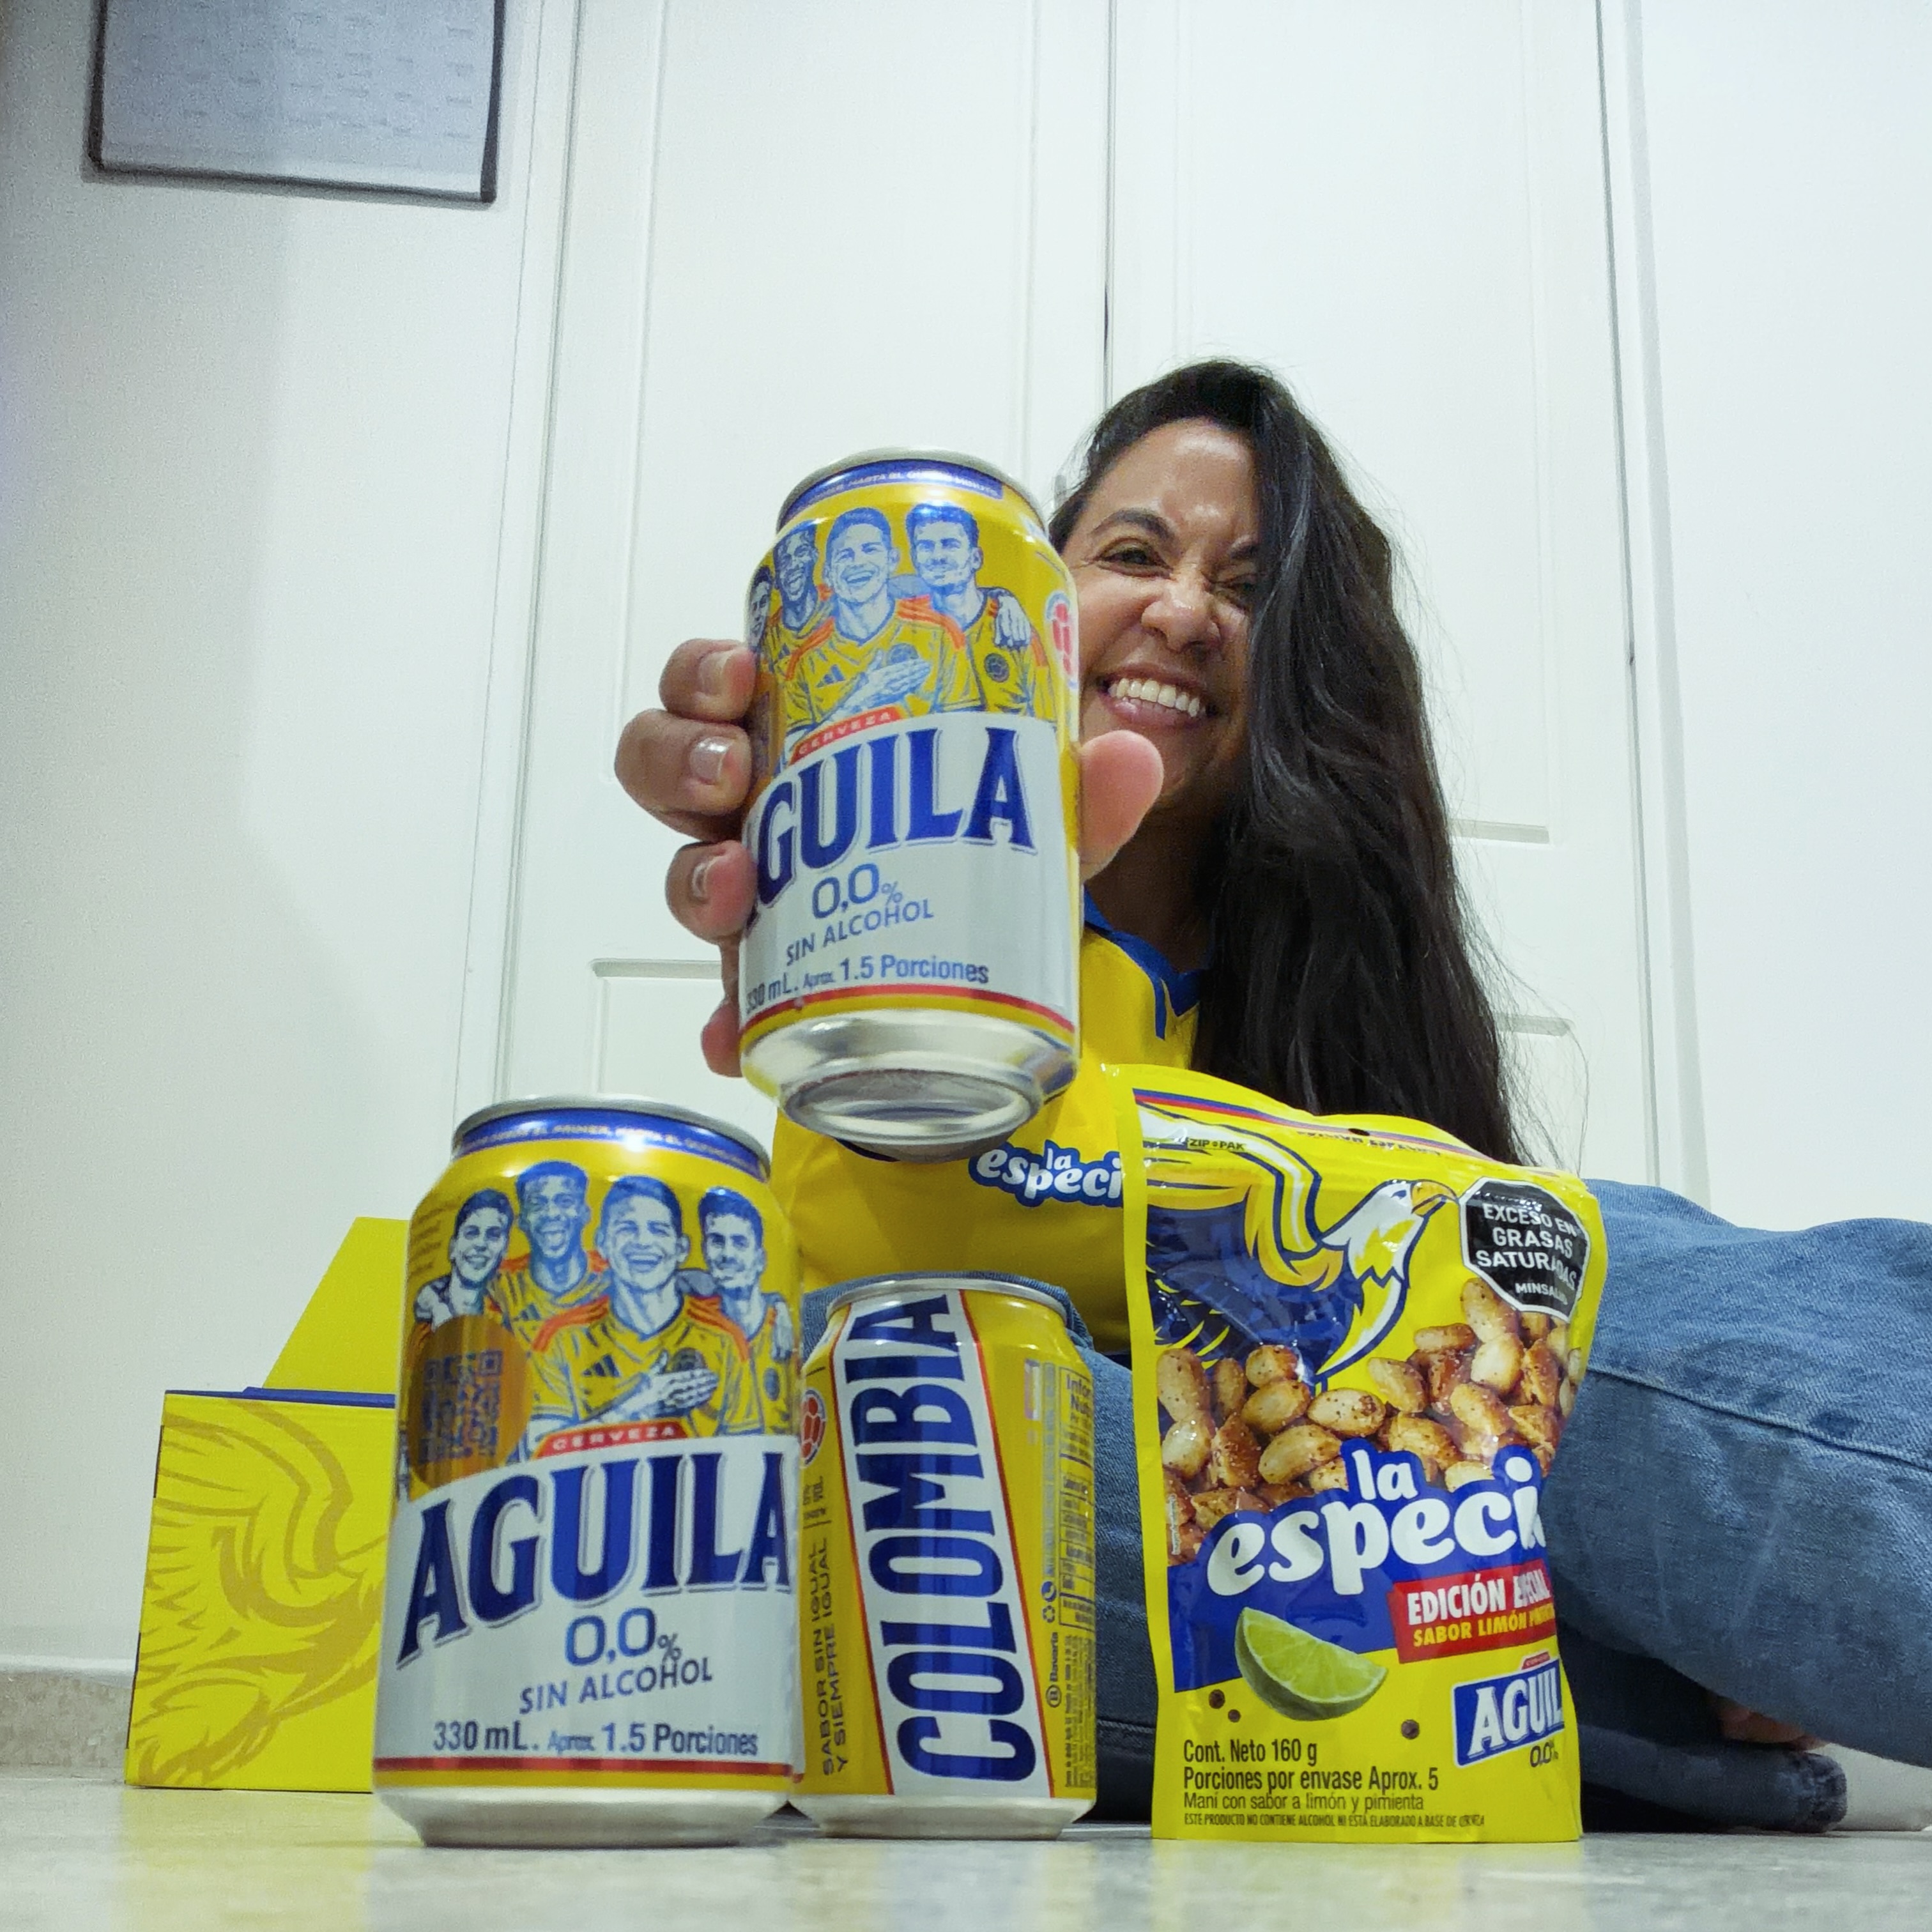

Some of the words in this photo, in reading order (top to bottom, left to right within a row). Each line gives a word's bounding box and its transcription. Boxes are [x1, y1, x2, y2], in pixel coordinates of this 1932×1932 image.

[799, 711, 893, 755] CERVEZA
[746, 726, 1037, 934] GUILA
[786, 933, 815, 966] SIN
[823, 899, 934, 947] ALCOHOL
[841, 958, 874, 982] 1.5
[880, 955, 989, 984] Porciones
[1046, 1148, 1071, 1170] la
[1482, 1204, 1552, 1227] EXCESO
[1554, 1218, 1577, 1238] EN
[1492, 1227, 1572, 1259] GRASAS
[552, 1424, 676, 1452] CERVEZA
[1351, 1449, 1418, 1501] la
[397, 1450, 791, 1669] AGUILA
[844, 1294, 1036, 1782] COLOMBIA
[808, 1543, 820, 1622] IGUAL
[820, 1538, 832, 1617] IGUAL
[1407, 1573, 1506, 1626] EDICIÓN
[1413, 1621, 1473, 1648] SABOR
[1477, 1609, 1528, 1637] LIMÓN
[813, 1629, 824, 1673] SIN
[519, 1681, 567, 1714] SIN
[579, 1657, 712, 1704] ALCOHOL
[825, 1623, 847, 1746] SIEMPRE
[433, 1720, 479, 1751] 330
[484, 1720, 539, 1752] mL.
[602, 1722, 645, 1752] 1.5
[654, 1723, 758, 1756] Porciones
[817, 1681, 834, 1775] SABOR
[836, 1756, 848, 1772] Y
[1184, 1739, 1225, 1763] Cont.
[1230, 1738, 1266, 1762] Neto
[1271, 1738, 1301, 1762] 160
[1307, 1743, 1317, 1767] g
[1184, 1766, 1262, 1790] Porciones
[1268, 1770, 1295, 1795] por
[1300, 1770, 1362, 1790] envase
[1368, 1766, 1422, 1795] Aprox.
[1429, 1767, 1439, 1790] 5
[1184, 1791, 1218, 1809] Maní
[1222, 1795, 1246, 1809] con
[1250, 1791, 1288, 1809] sabor
[1292, 1795, 1301, 1809] a
[1306, 1791, 1346, 1810] limón
[1351, 1796, 1360, 1814] y
[1365, 1793, 1424, 1814] pimienta
[1184, 1813, 1202, 1825] ESTE
[1204, 1813, 1245, 1826] PRODUCTO
[1298, 1814, 1336, 1827] ALCOHOL
[1425, 1815, 1445, 1827] BASE
[1446, 1815, 1457, 1827] DE
